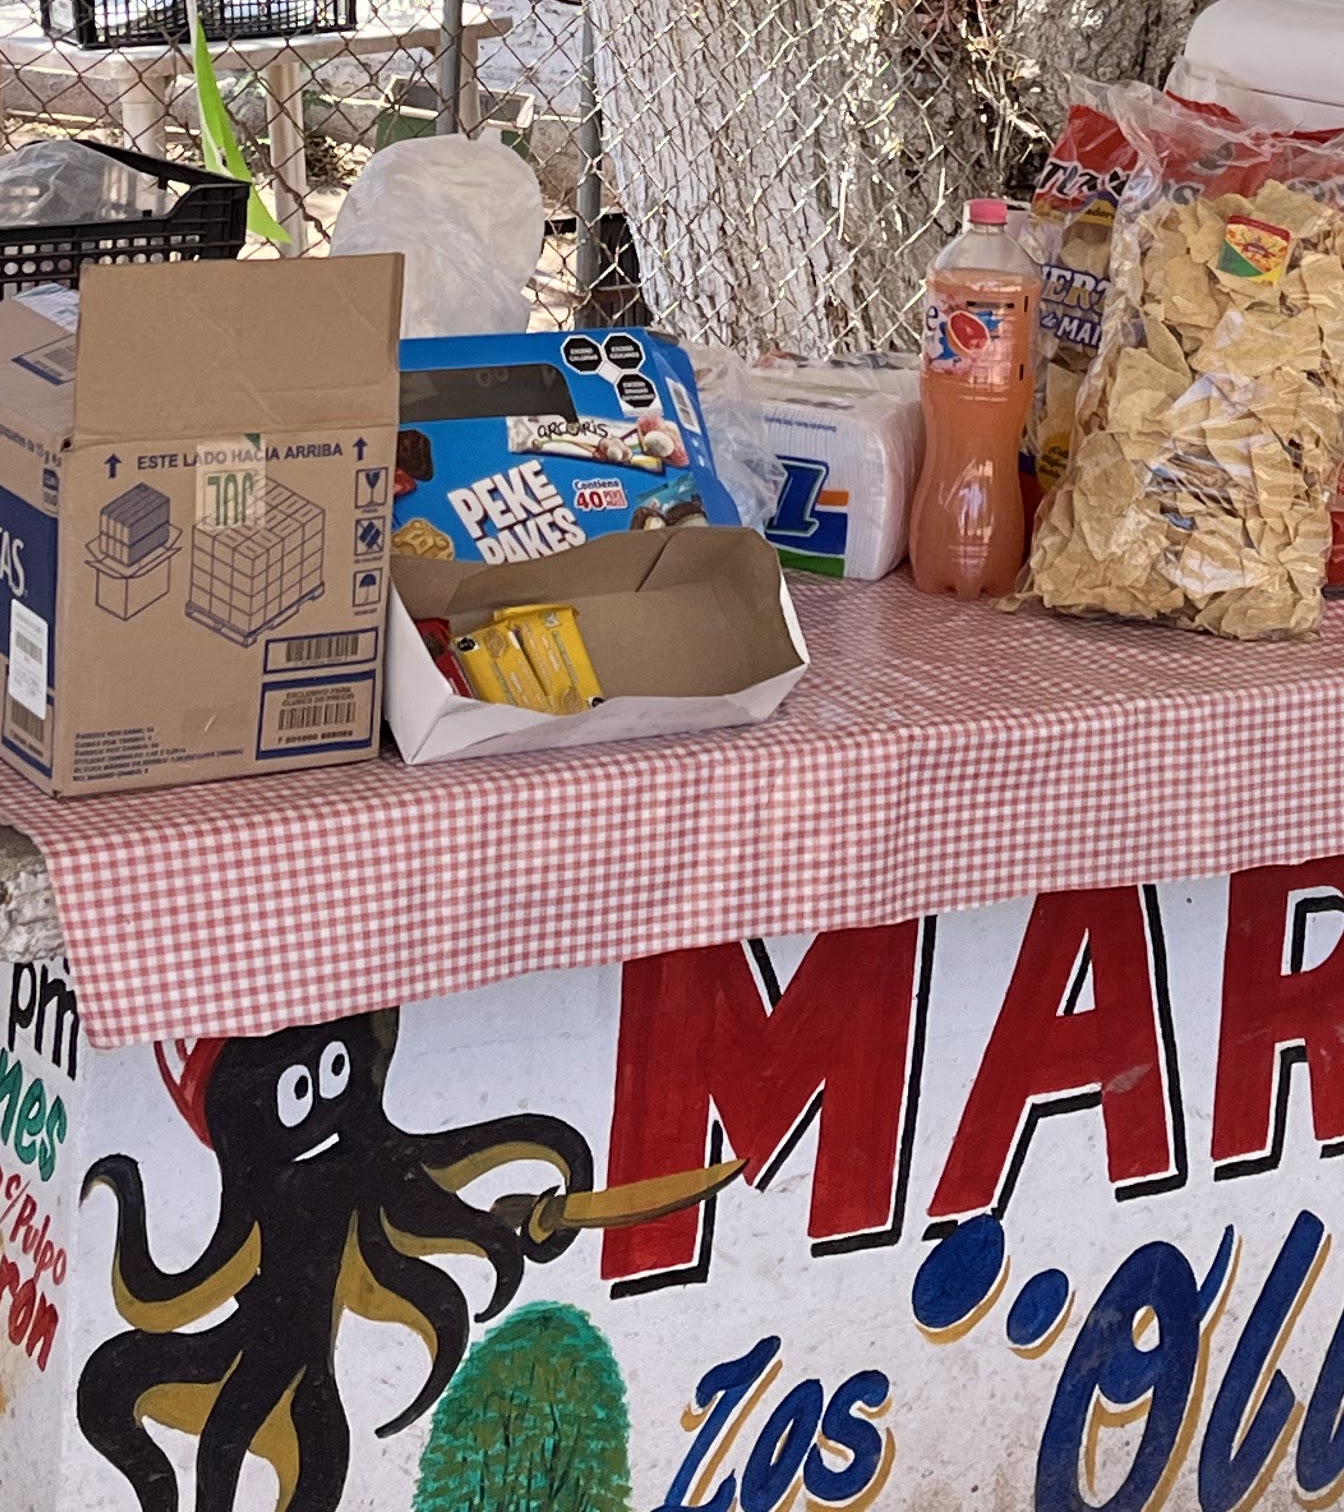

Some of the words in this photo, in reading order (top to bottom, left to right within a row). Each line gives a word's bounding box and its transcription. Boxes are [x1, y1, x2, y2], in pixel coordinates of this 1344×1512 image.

[1057, 316, 1102, 347] MAI
[137, 453, 179, 471] ESTE
[183, 449, 227, 468] LADO
[231, 445, 281, 464] HACIA
[284, 443, 344, 460] ARRIBA
[207, 472, 254, 527] JUL
[447, 459, 564, 539] PEKE
[576, 491, 603, 509] 40
[476, 506, 586, 565] PAKES
[7, 961, 80, 1082] pm
[654, 1333, 894, 1512] Los
